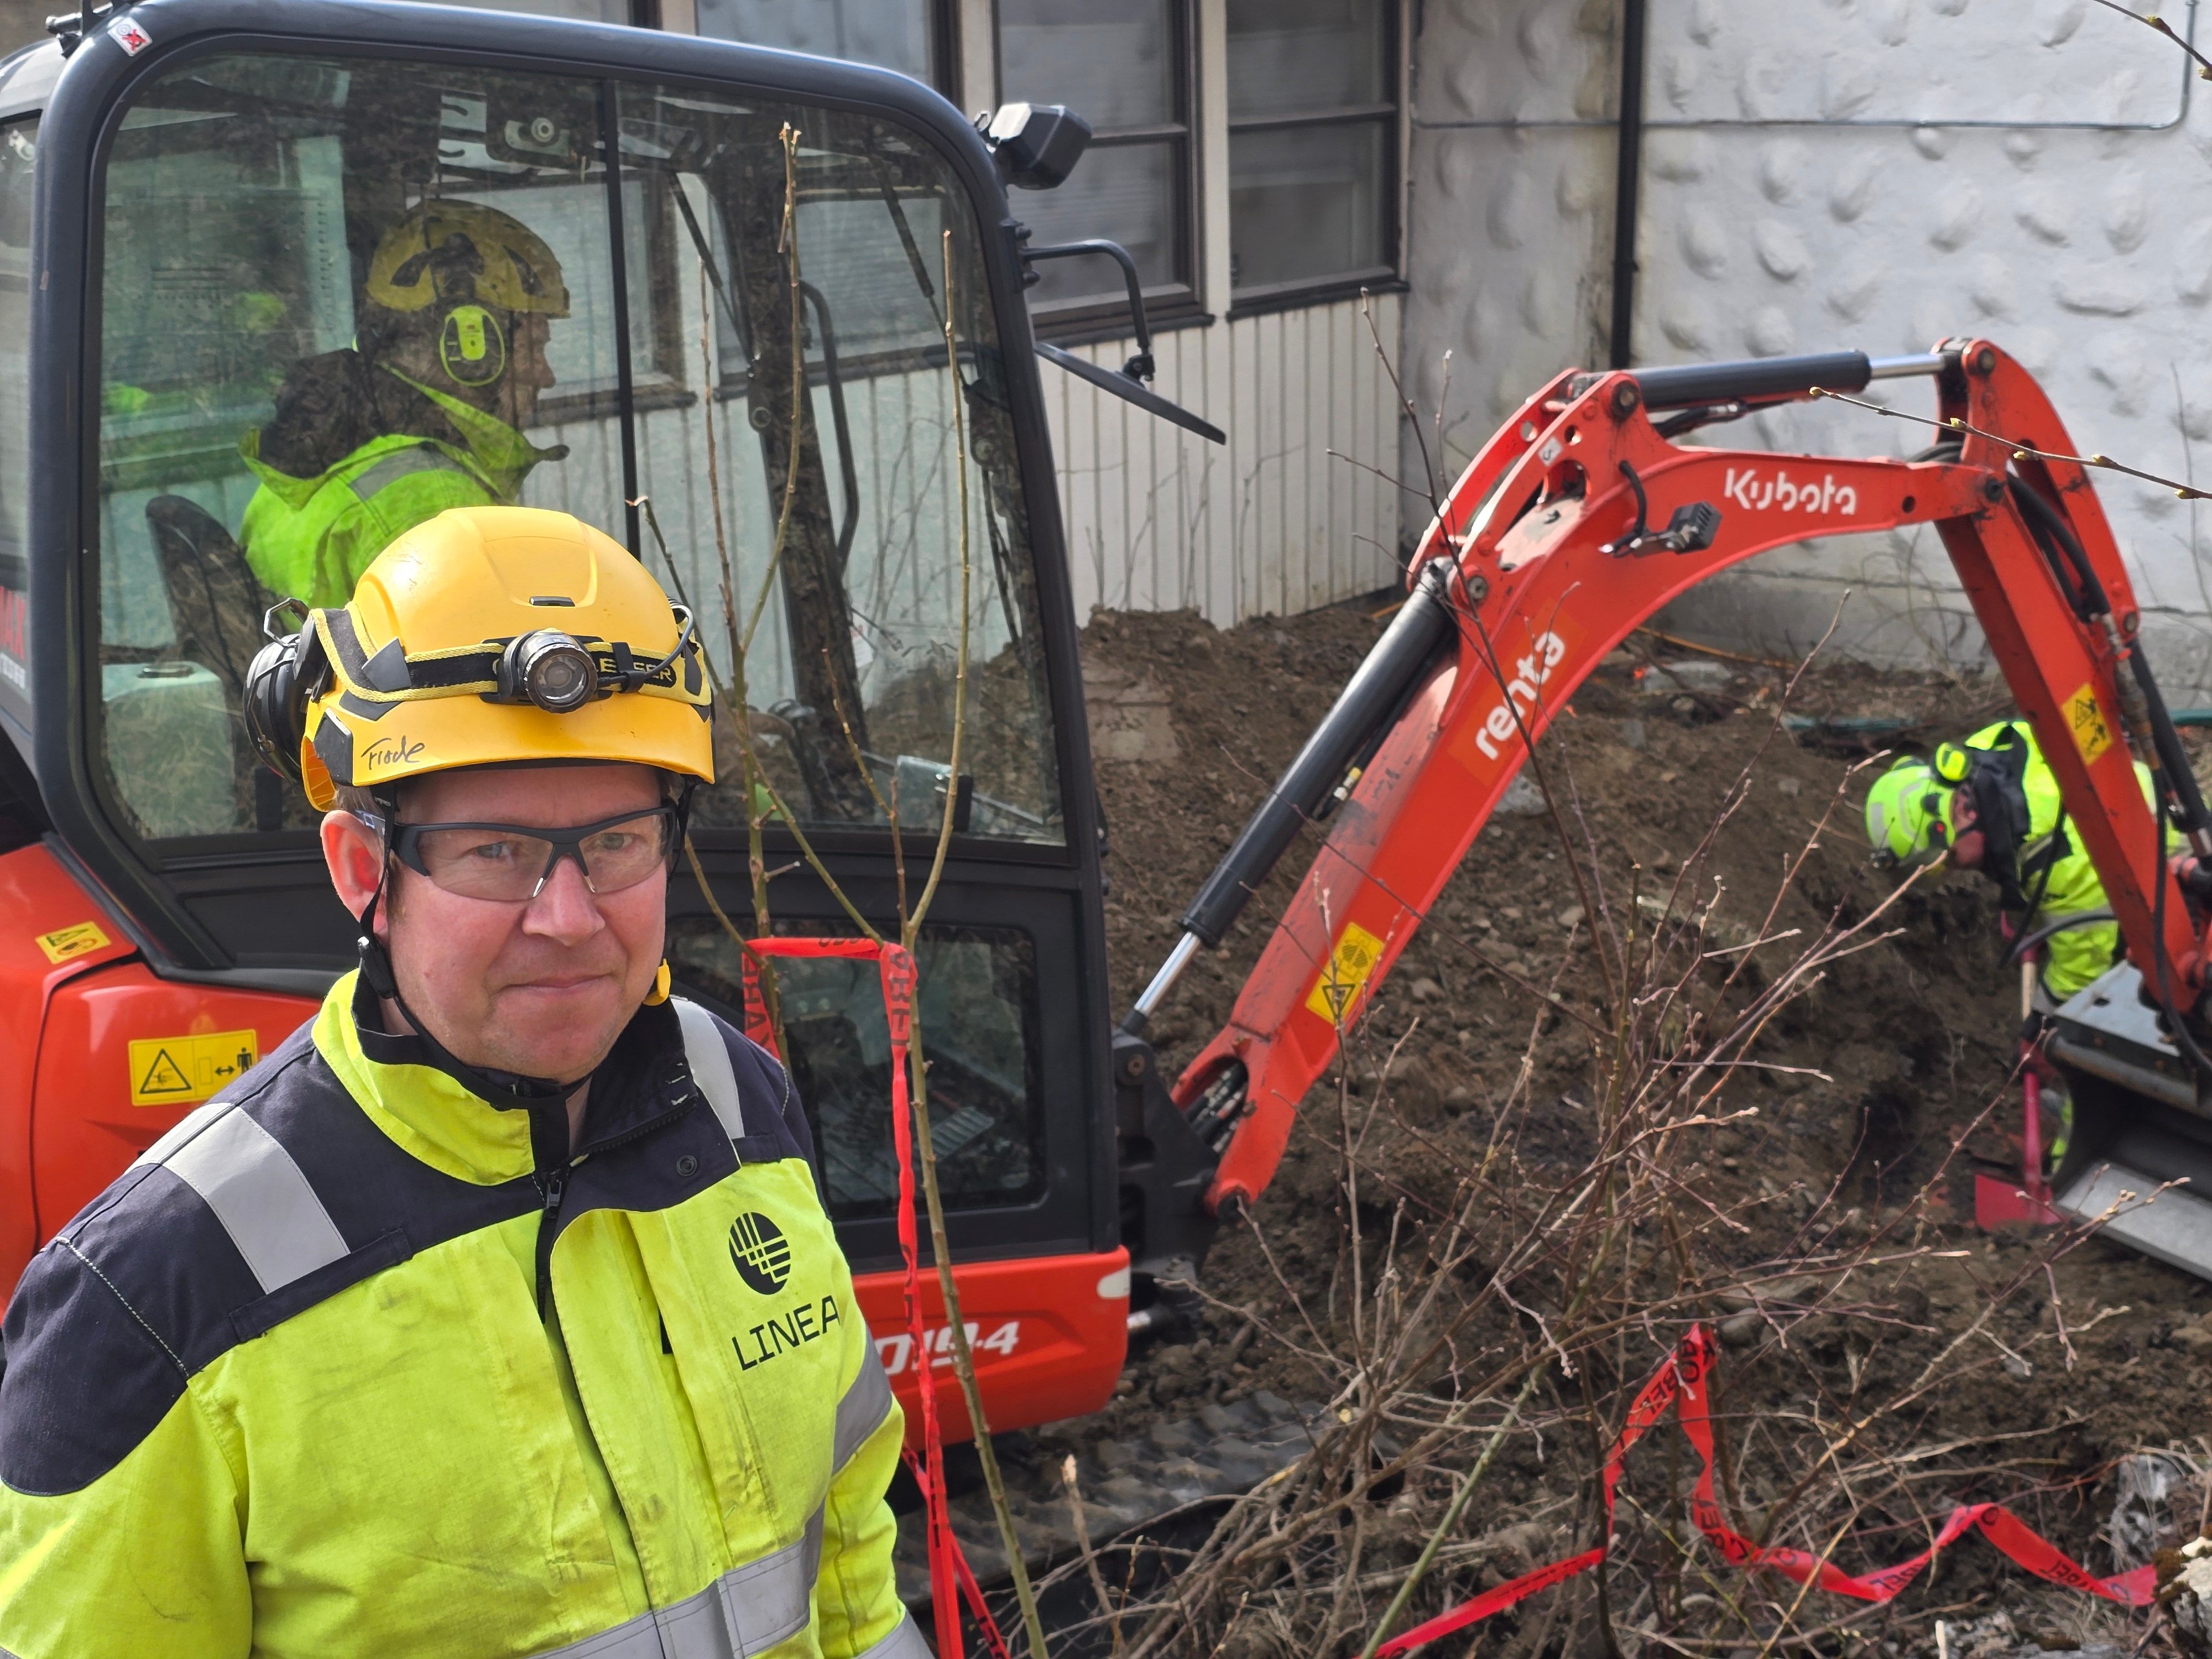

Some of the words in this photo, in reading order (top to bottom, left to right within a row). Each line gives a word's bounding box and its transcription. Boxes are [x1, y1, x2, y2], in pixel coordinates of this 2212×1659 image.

[1724, 468, 1857, 515] Kubota
[1475, 631, 1566, 760] renta
[732, 1295, 841, 1371] LINEA
